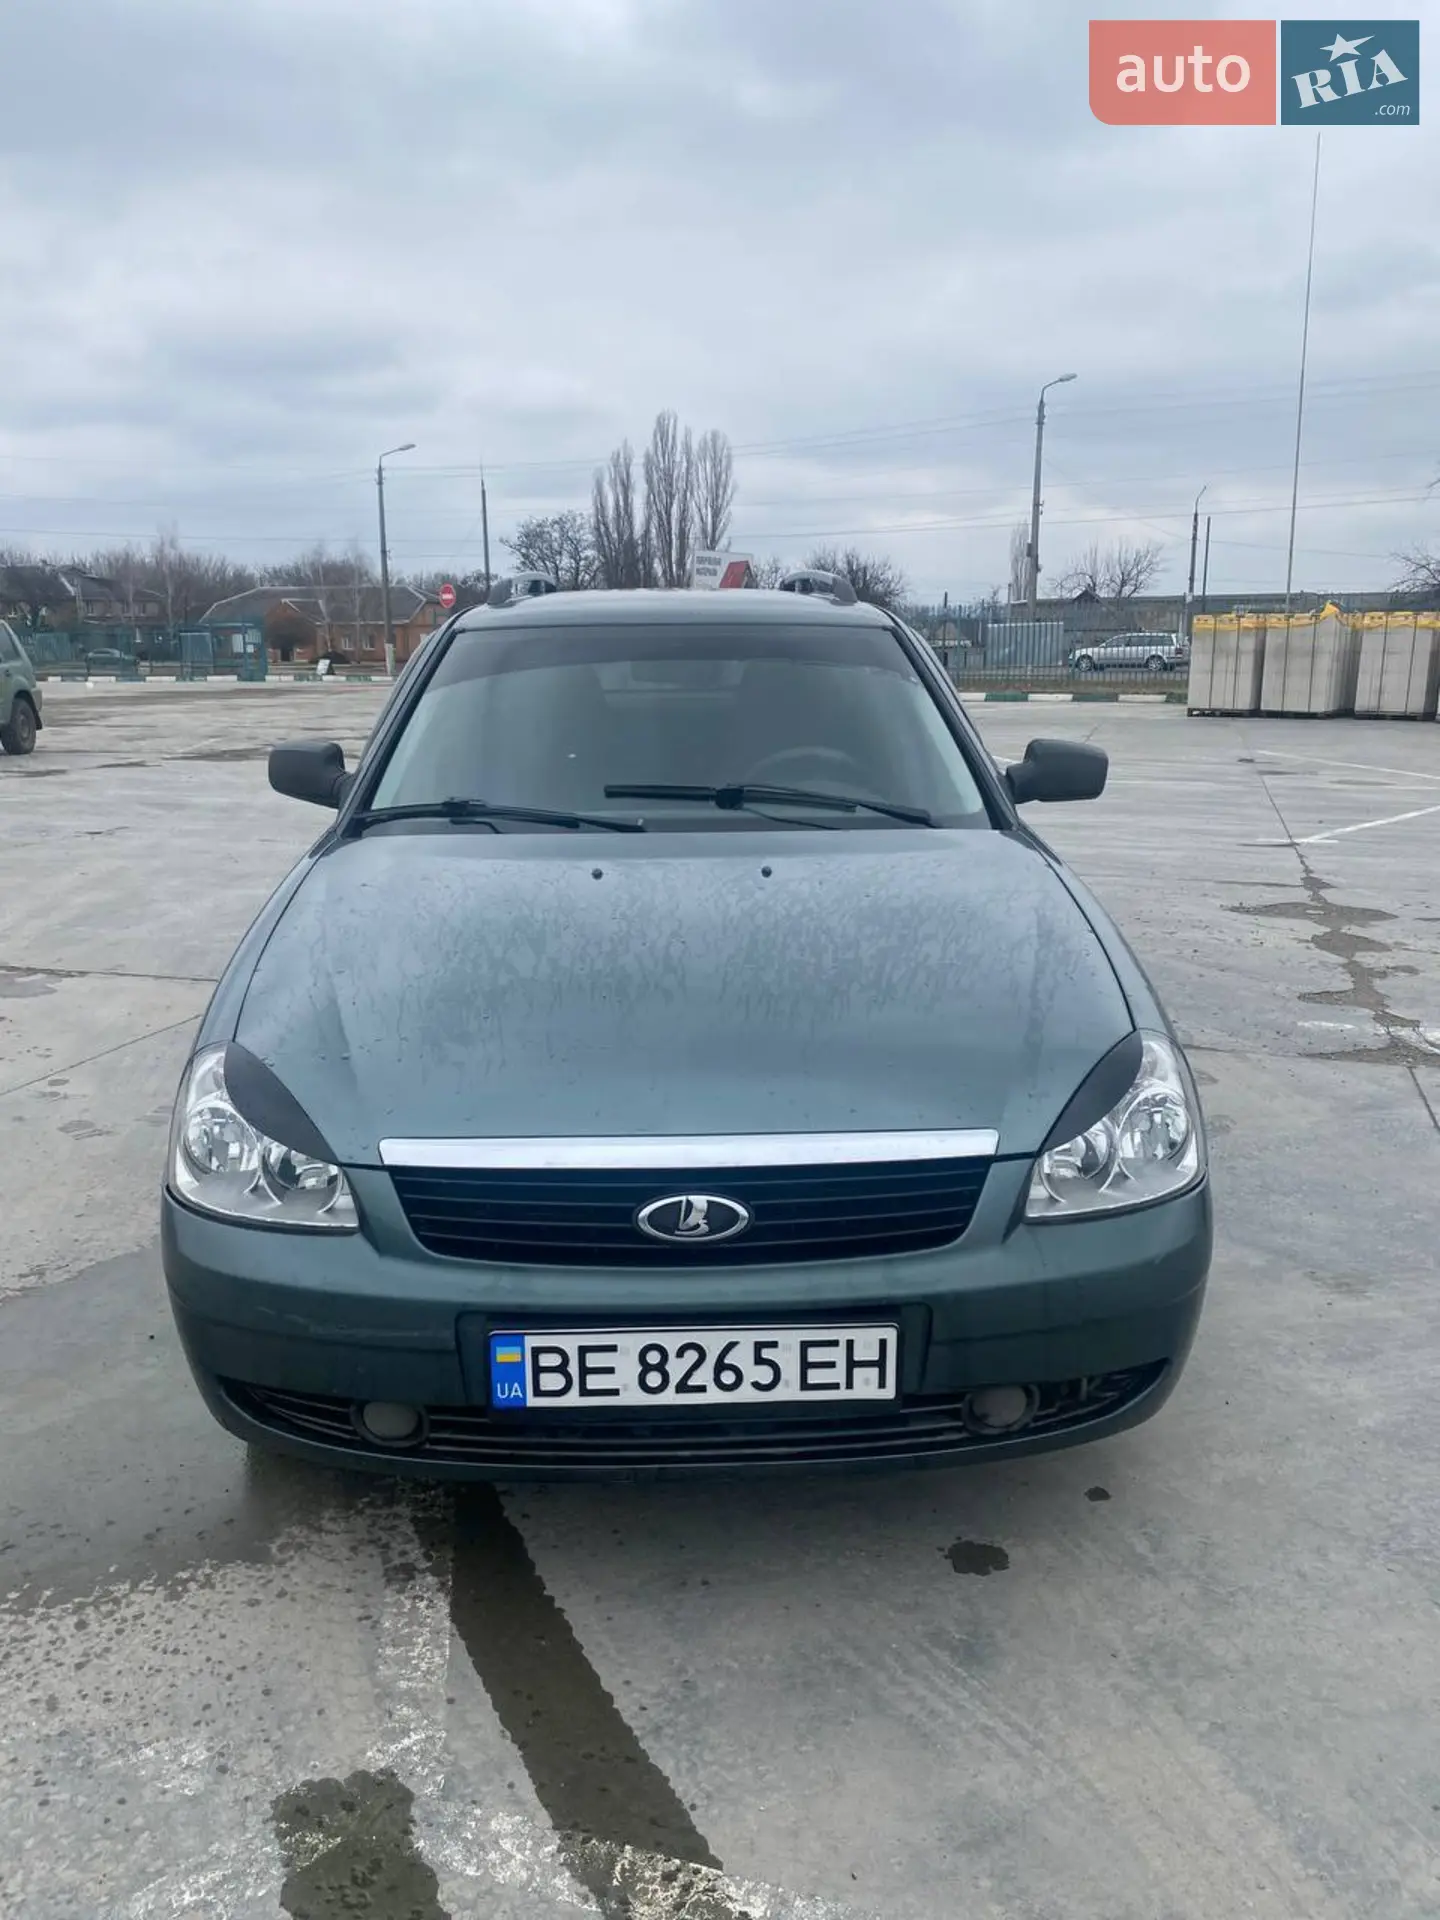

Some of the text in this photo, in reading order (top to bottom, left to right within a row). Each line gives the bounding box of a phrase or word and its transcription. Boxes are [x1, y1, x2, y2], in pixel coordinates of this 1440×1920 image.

[530, 1337, 888, 1398] BE 8265 EH
[496, 1381, 523, 1400] UA
